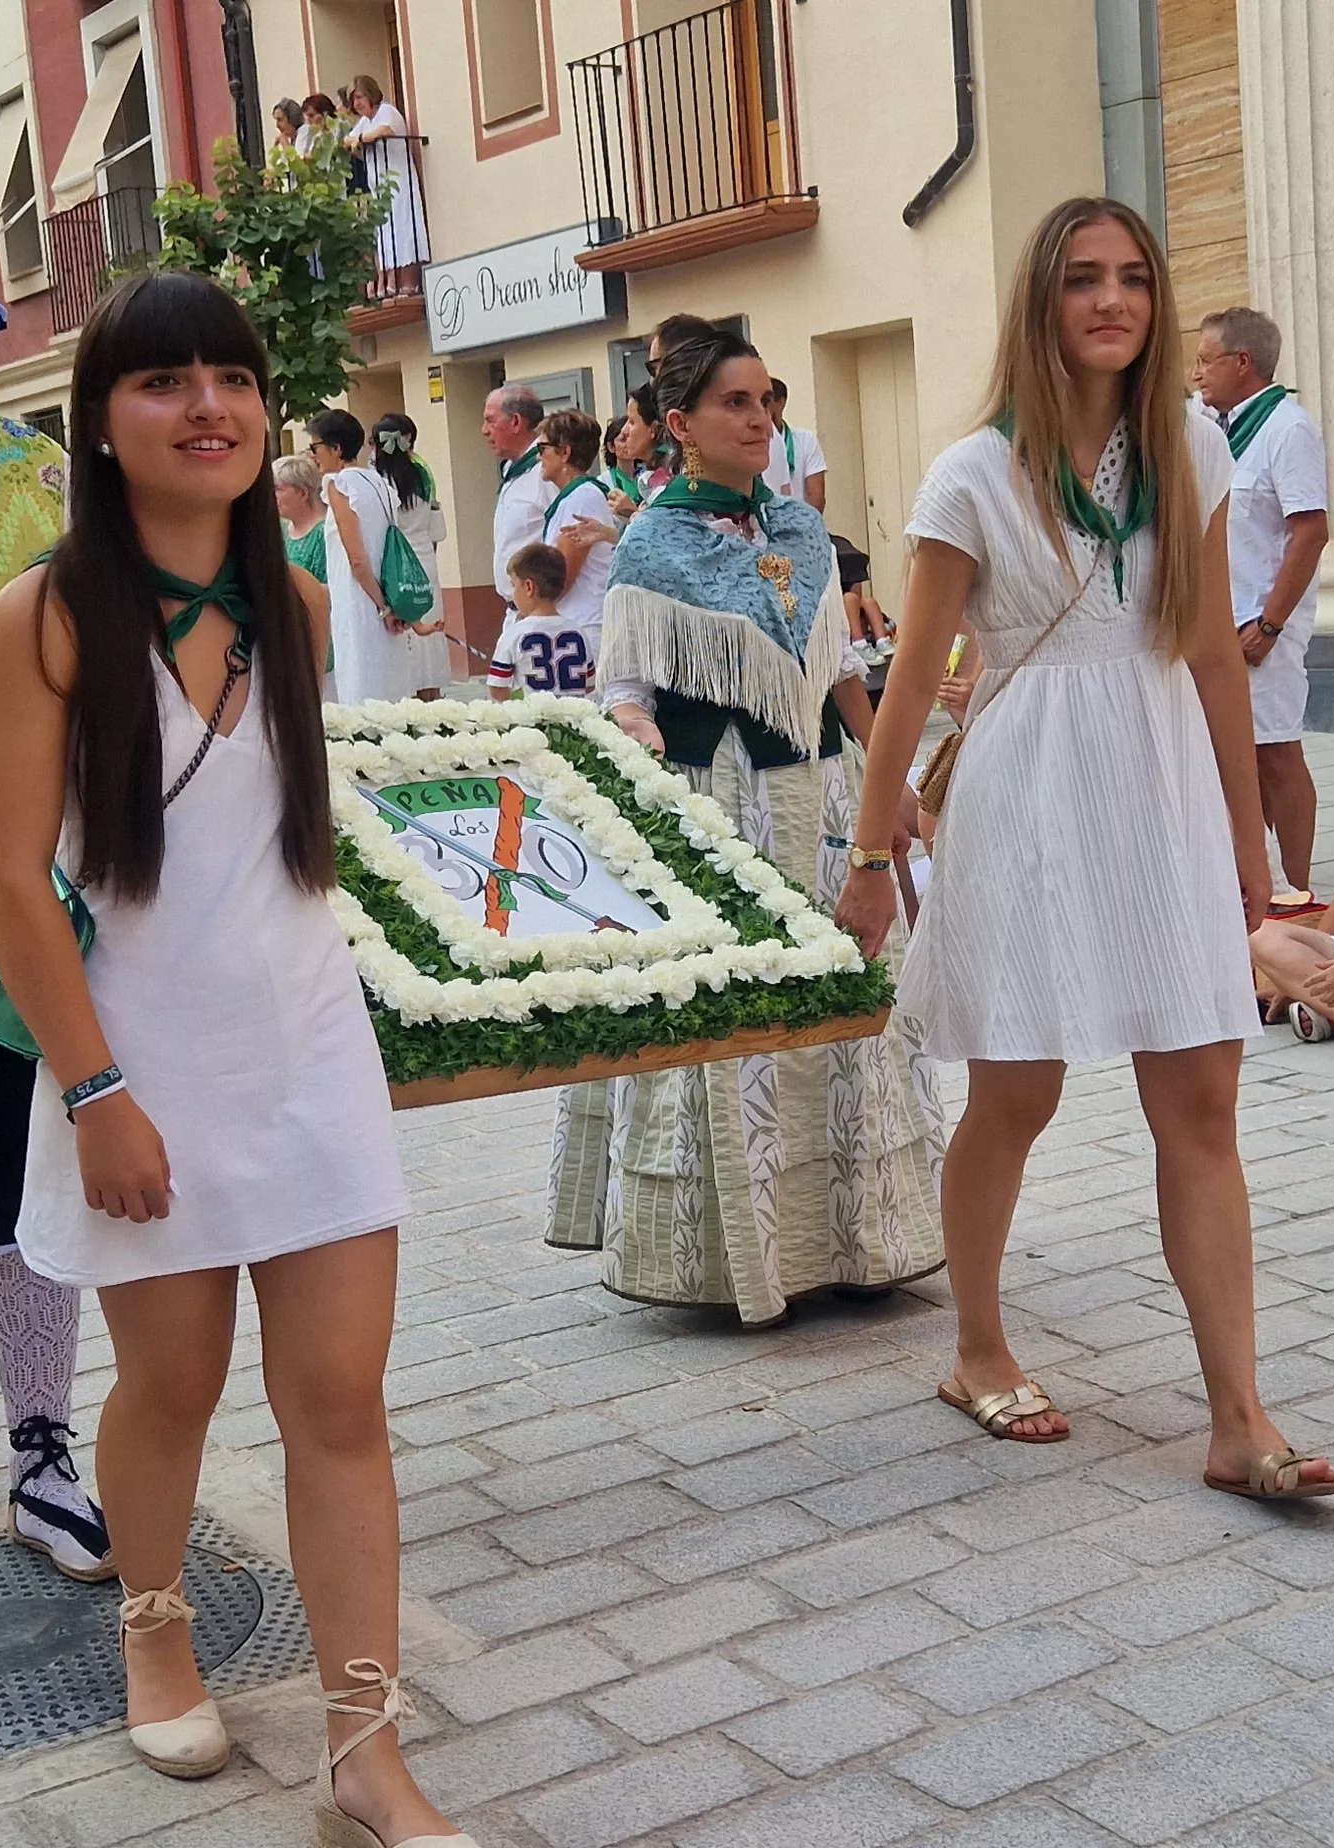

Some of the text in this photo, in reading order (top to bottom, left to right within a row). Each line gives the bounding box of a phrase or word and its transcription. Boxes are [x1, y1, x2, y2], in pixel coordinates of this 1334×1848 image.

[476, 246, 589, 316] Dream shop
[519, 630, 587, 692] 32
[396, 780, 495, 812] PEÑA
[449, 813, 490, 837] Los
[76, 1081, 94, 1097] 25
